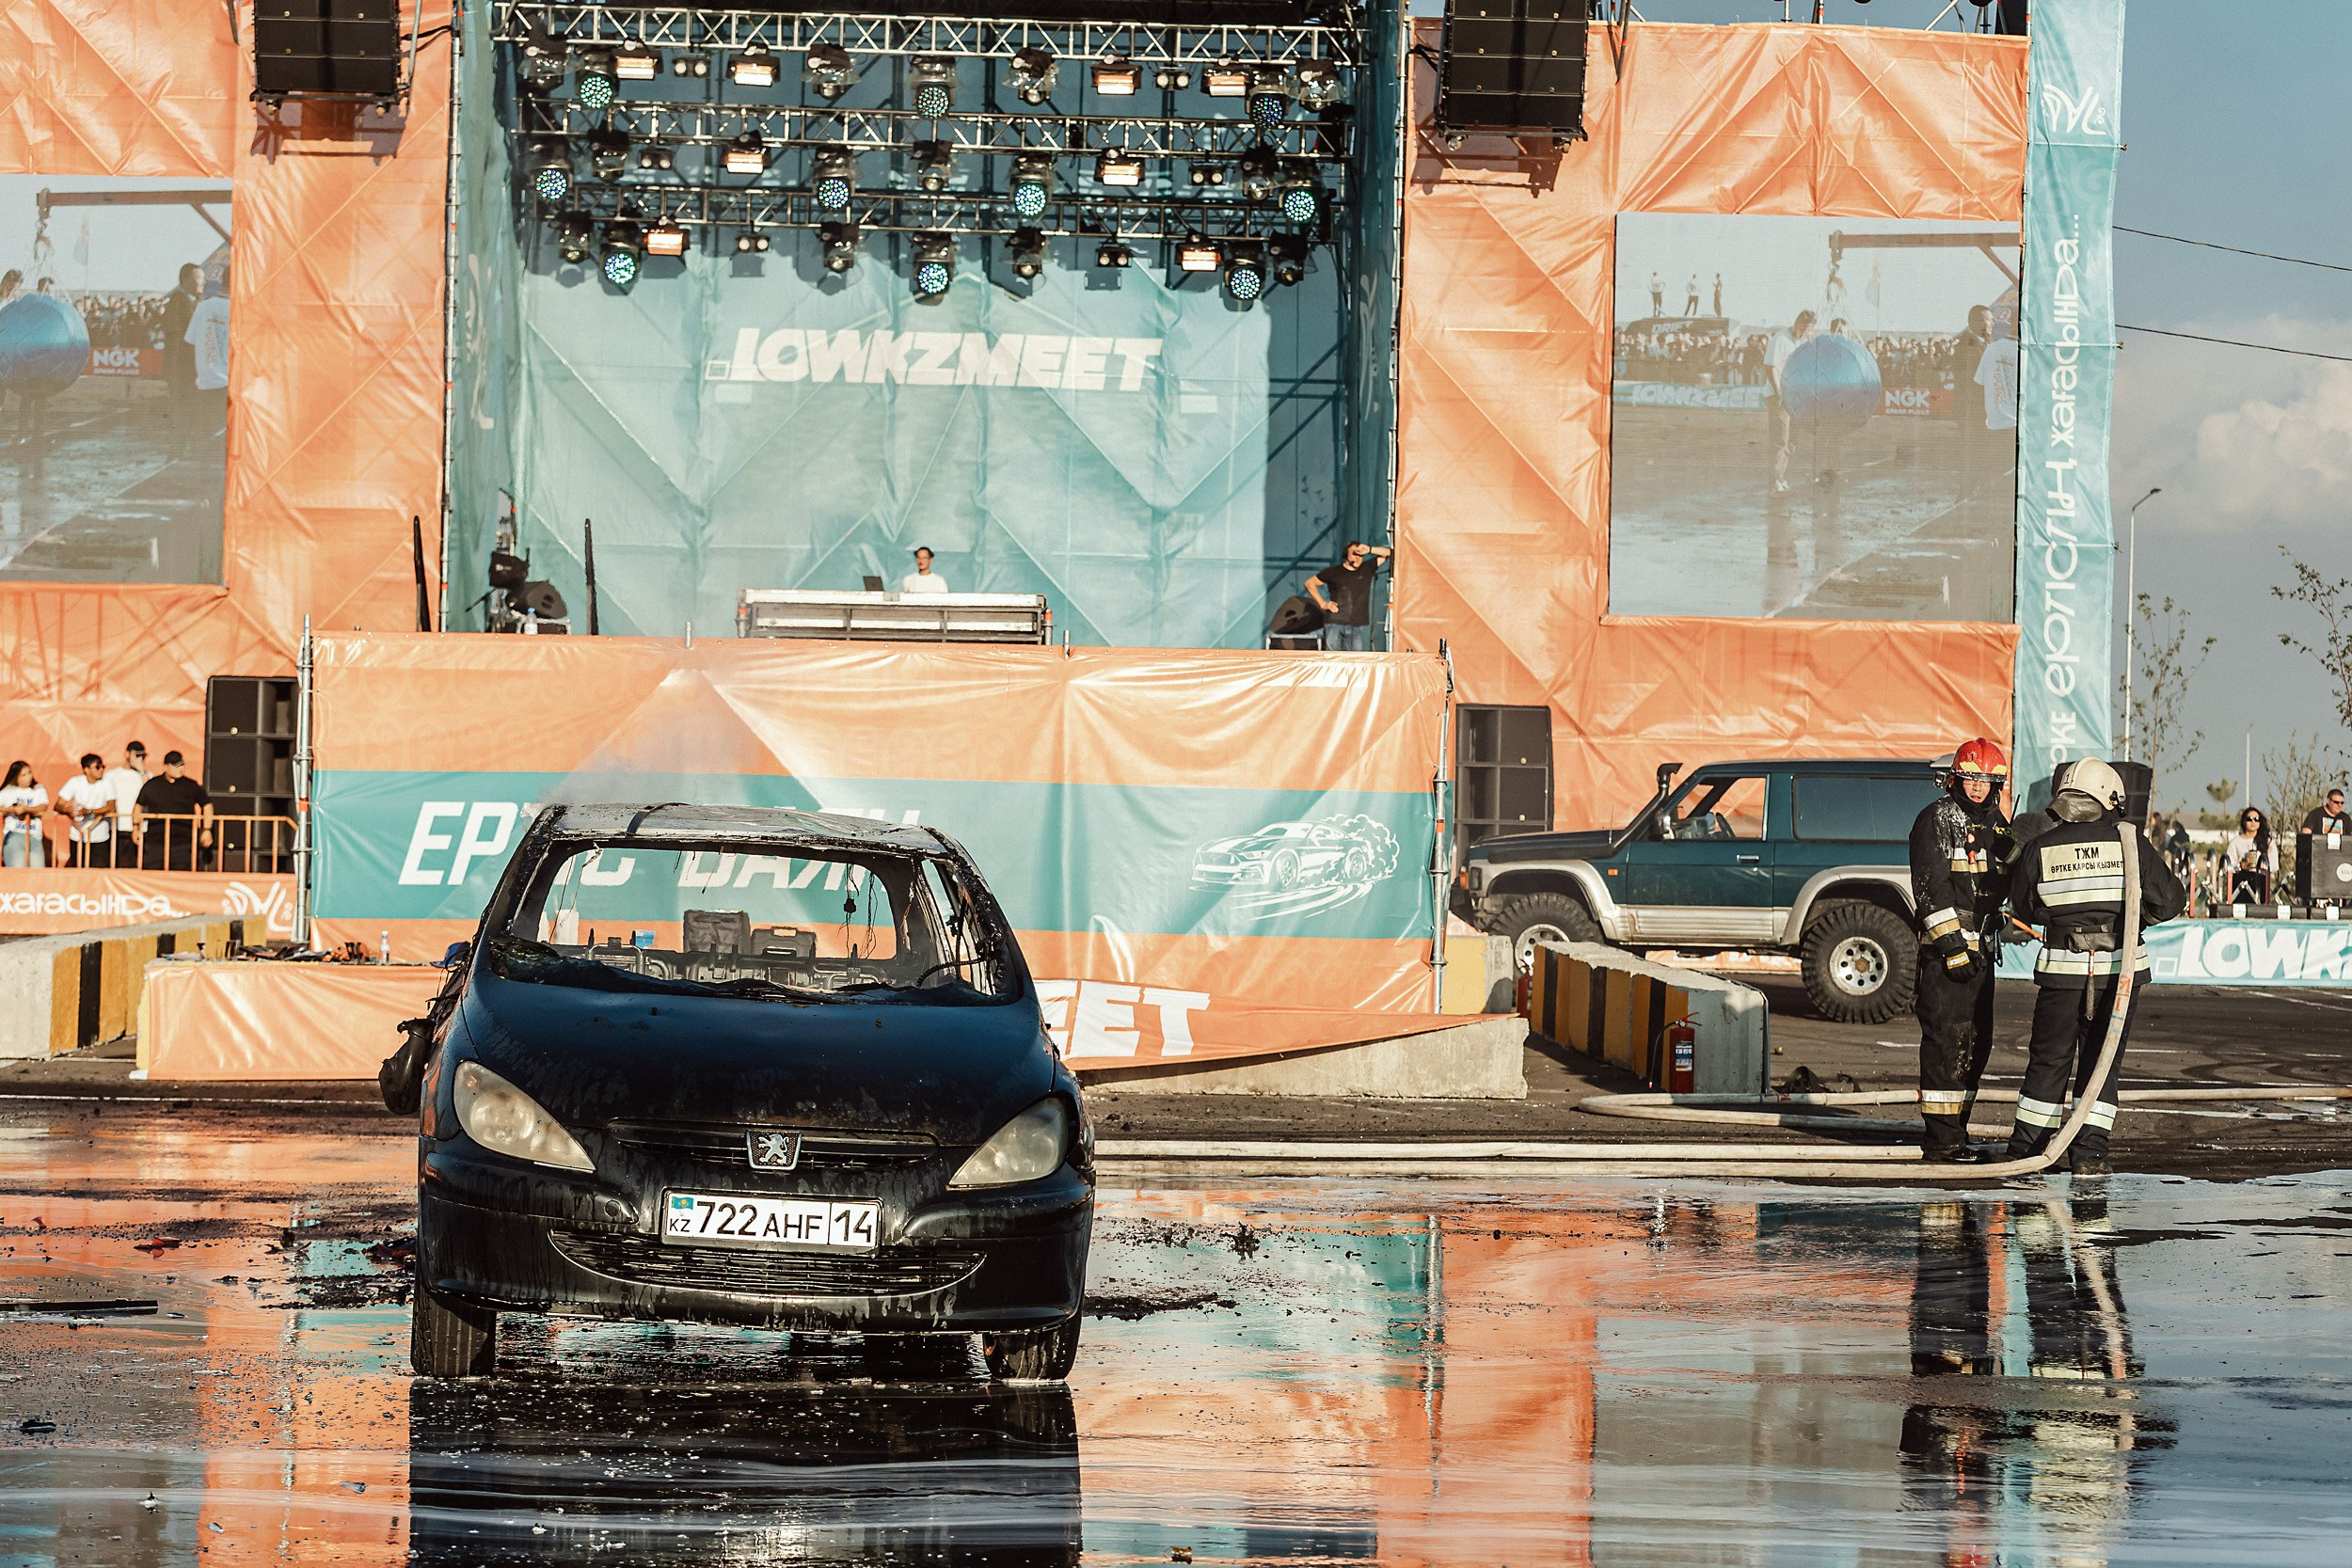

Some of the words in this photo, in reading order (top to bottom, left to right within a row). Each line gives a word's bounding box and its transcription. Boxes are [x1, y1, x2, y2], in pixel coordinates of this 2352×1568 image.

[92, 347, 140, 368] NGK
[729, 327, 1164, 393] LOWKZMEET
[1884, 388, 1931, 407] NGK
[2074, 847, 2100, 860] ТЖМ
[2176, 927, 2352, 980] LOWK
[669, 1218, 691, 1232] KZ
[696, 1201, 758, 1237] 722
[762, 1212, 823, 1240] AHF
[834, 1209, 873, 1243] 14
